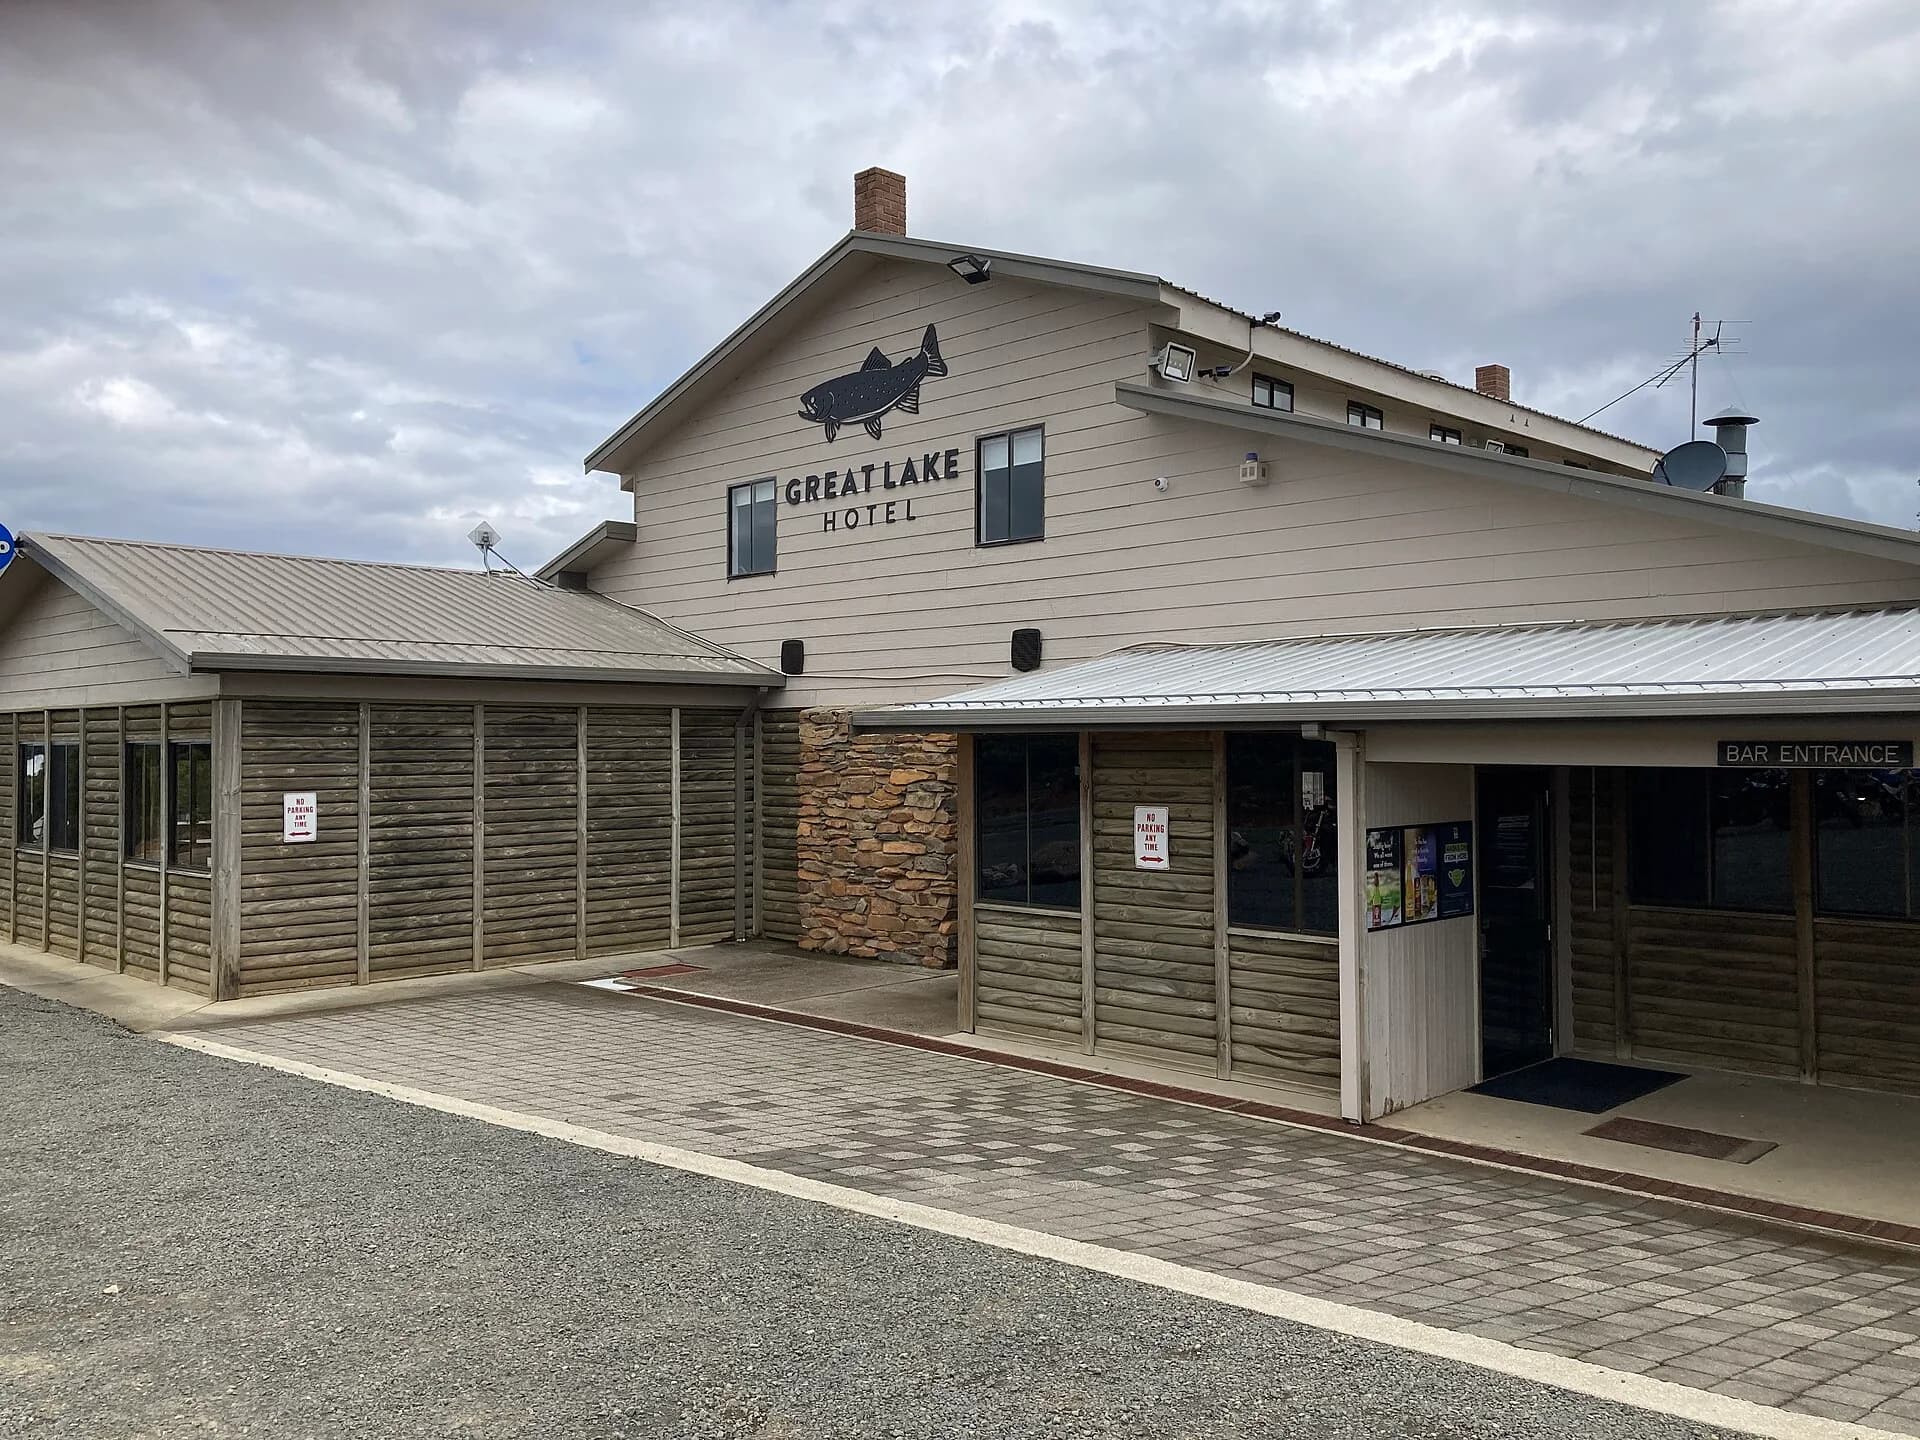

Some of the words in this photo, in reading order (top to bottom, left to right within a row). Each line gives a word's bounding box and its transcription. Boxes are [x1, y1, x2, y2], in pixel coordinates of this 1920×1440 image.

[785, 463, 875, 505] GREAT
[884, 448, 959, 489] LAKE
[824, 499, 916, 532] HOTEL
[1726, 745, 1769, 762] BAR
[1780, 745, 1900, 763] ENTRANCE
[287, 806, 314, 814] PARKING
[1146, 813, 1156, 822] NO
[1137, 824, 1165, 833] PARKING
[1144, 843, 1158, 851] TIME
